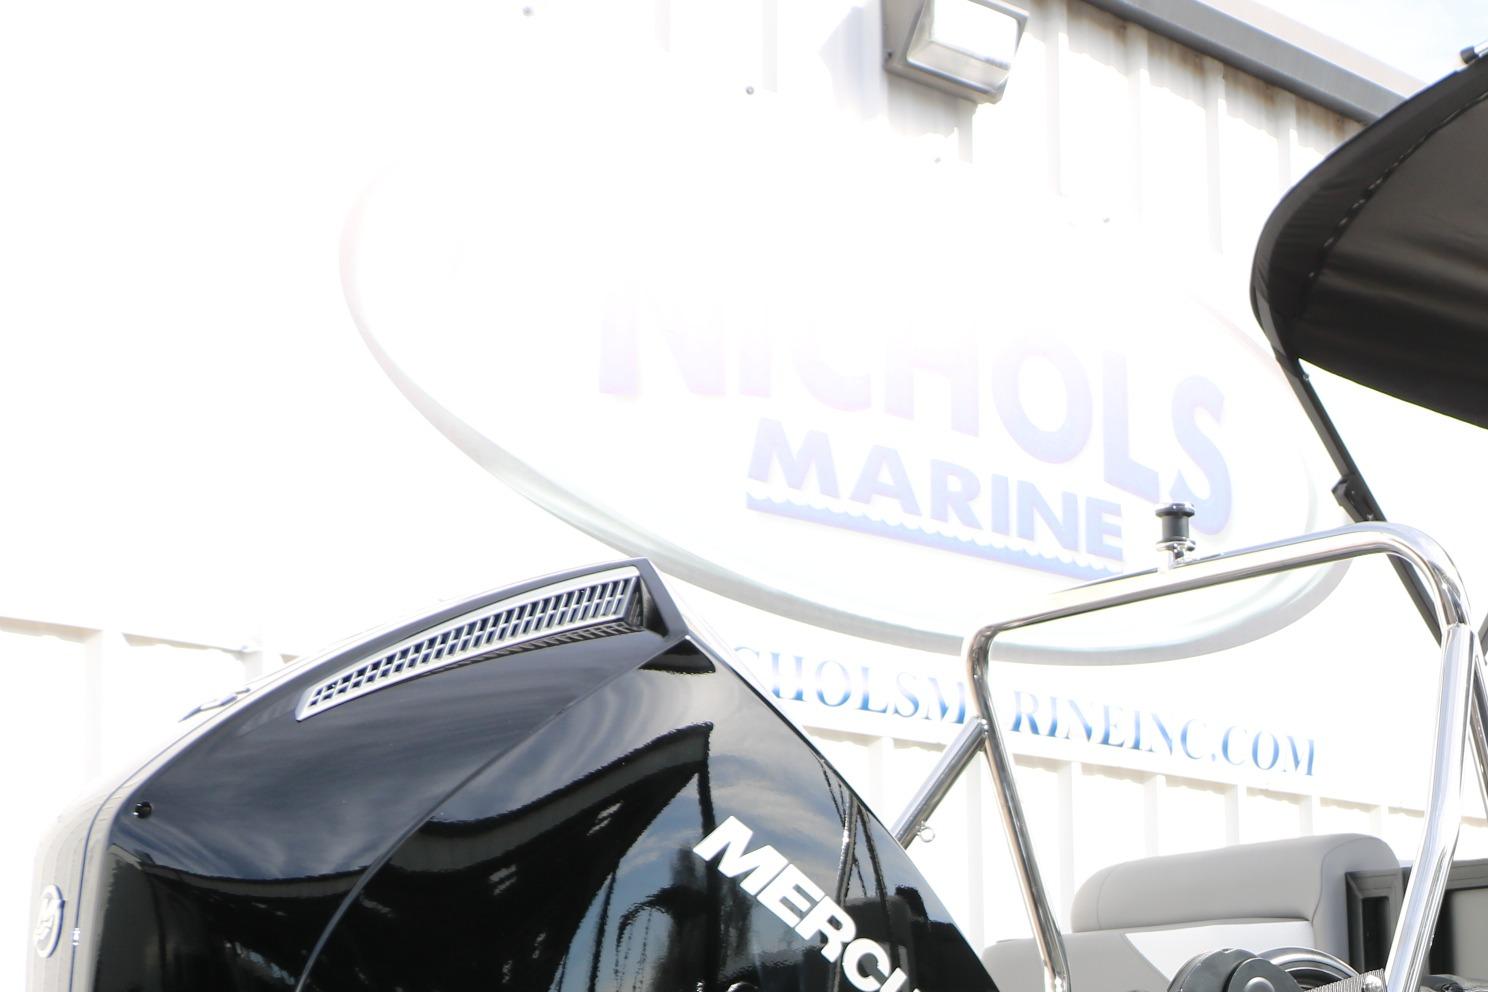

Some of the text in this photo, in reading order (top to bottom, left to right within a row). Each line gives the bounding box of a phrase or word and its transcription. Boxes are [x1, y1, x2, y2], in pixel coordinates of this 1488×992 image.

[597, 275, 1233, 538] NICHOLS
[747, 418, 1126, 562] MARINE
[733, 646, 1318, 778] HOLSMRINEINC.COM
